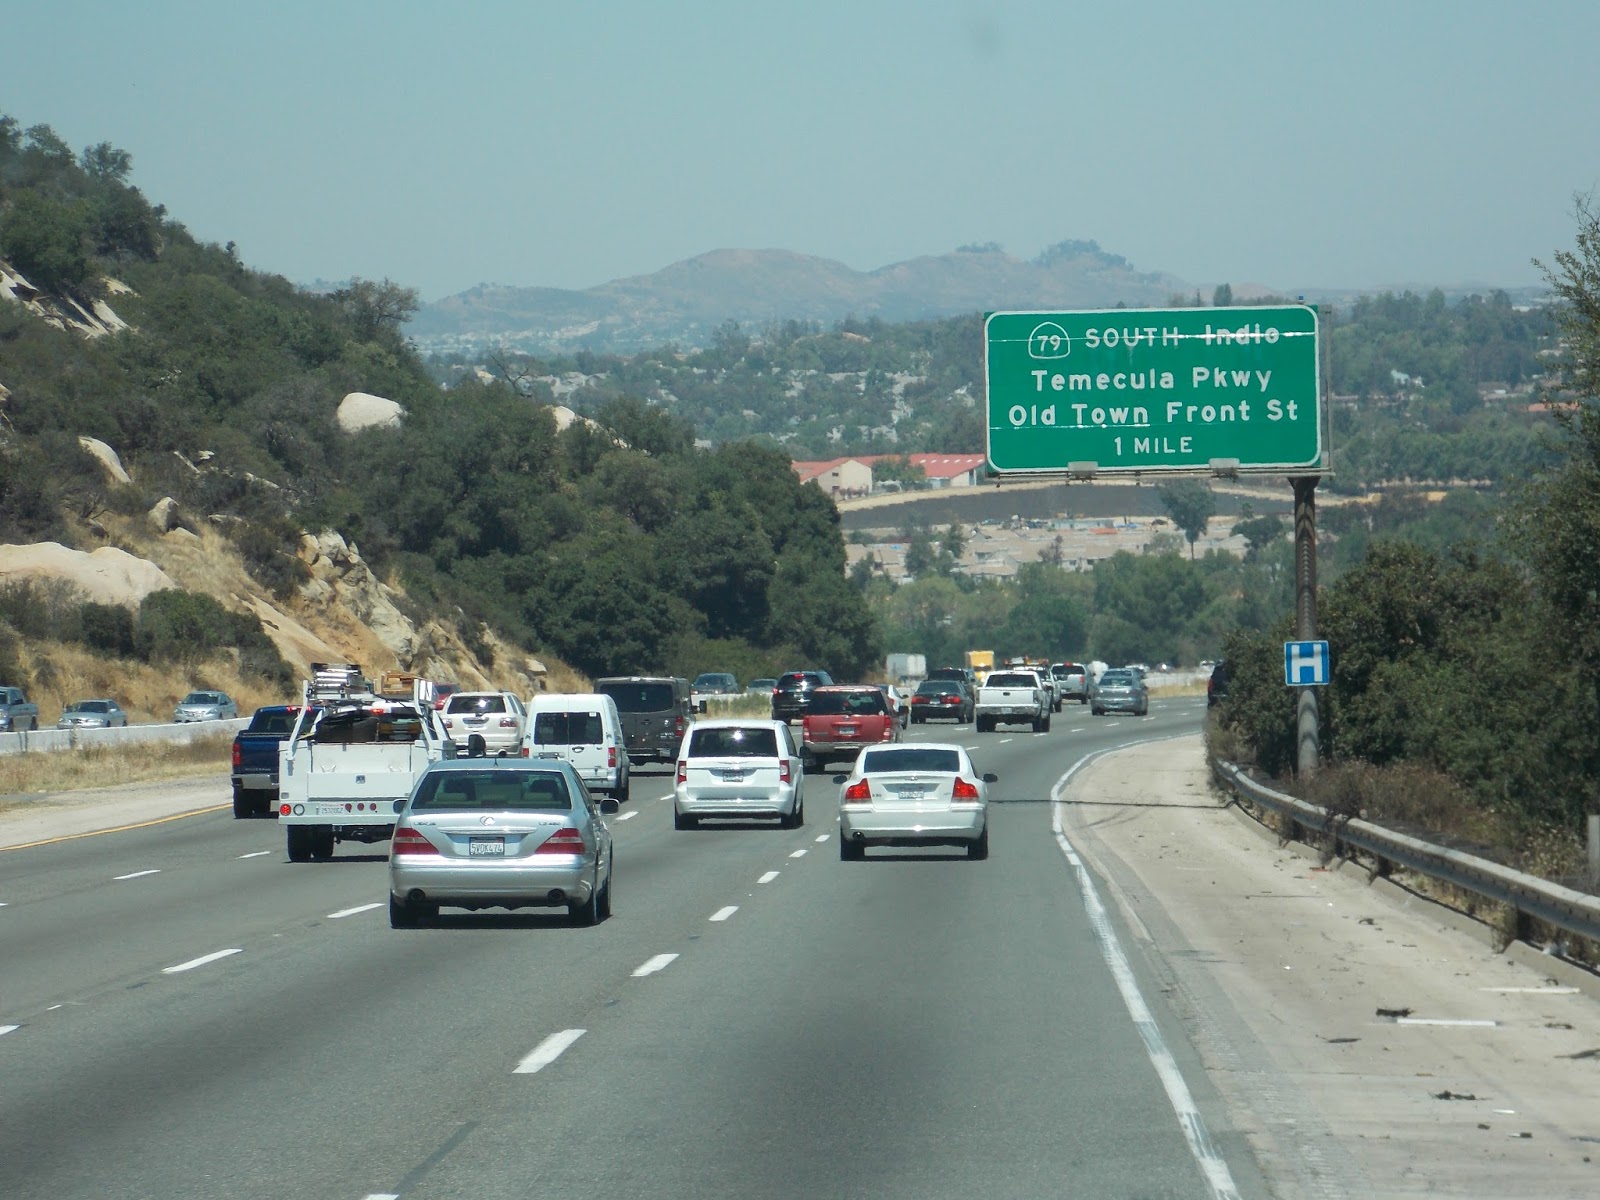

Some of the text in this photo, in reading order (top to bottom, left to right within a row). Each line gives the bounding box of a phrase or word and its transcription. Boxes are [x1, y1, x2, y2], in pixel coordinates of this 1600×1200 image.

[1037, 324, 1279, 352] 79 SOUTH Indio
[1031, 367, 1272, 392] Temecula Pkwy
[1009, 399, 1298, 426] Old Town Front St
[1115, 437, 1193, 456] 1 MILE
[1292, 644, 1323, 682] H
